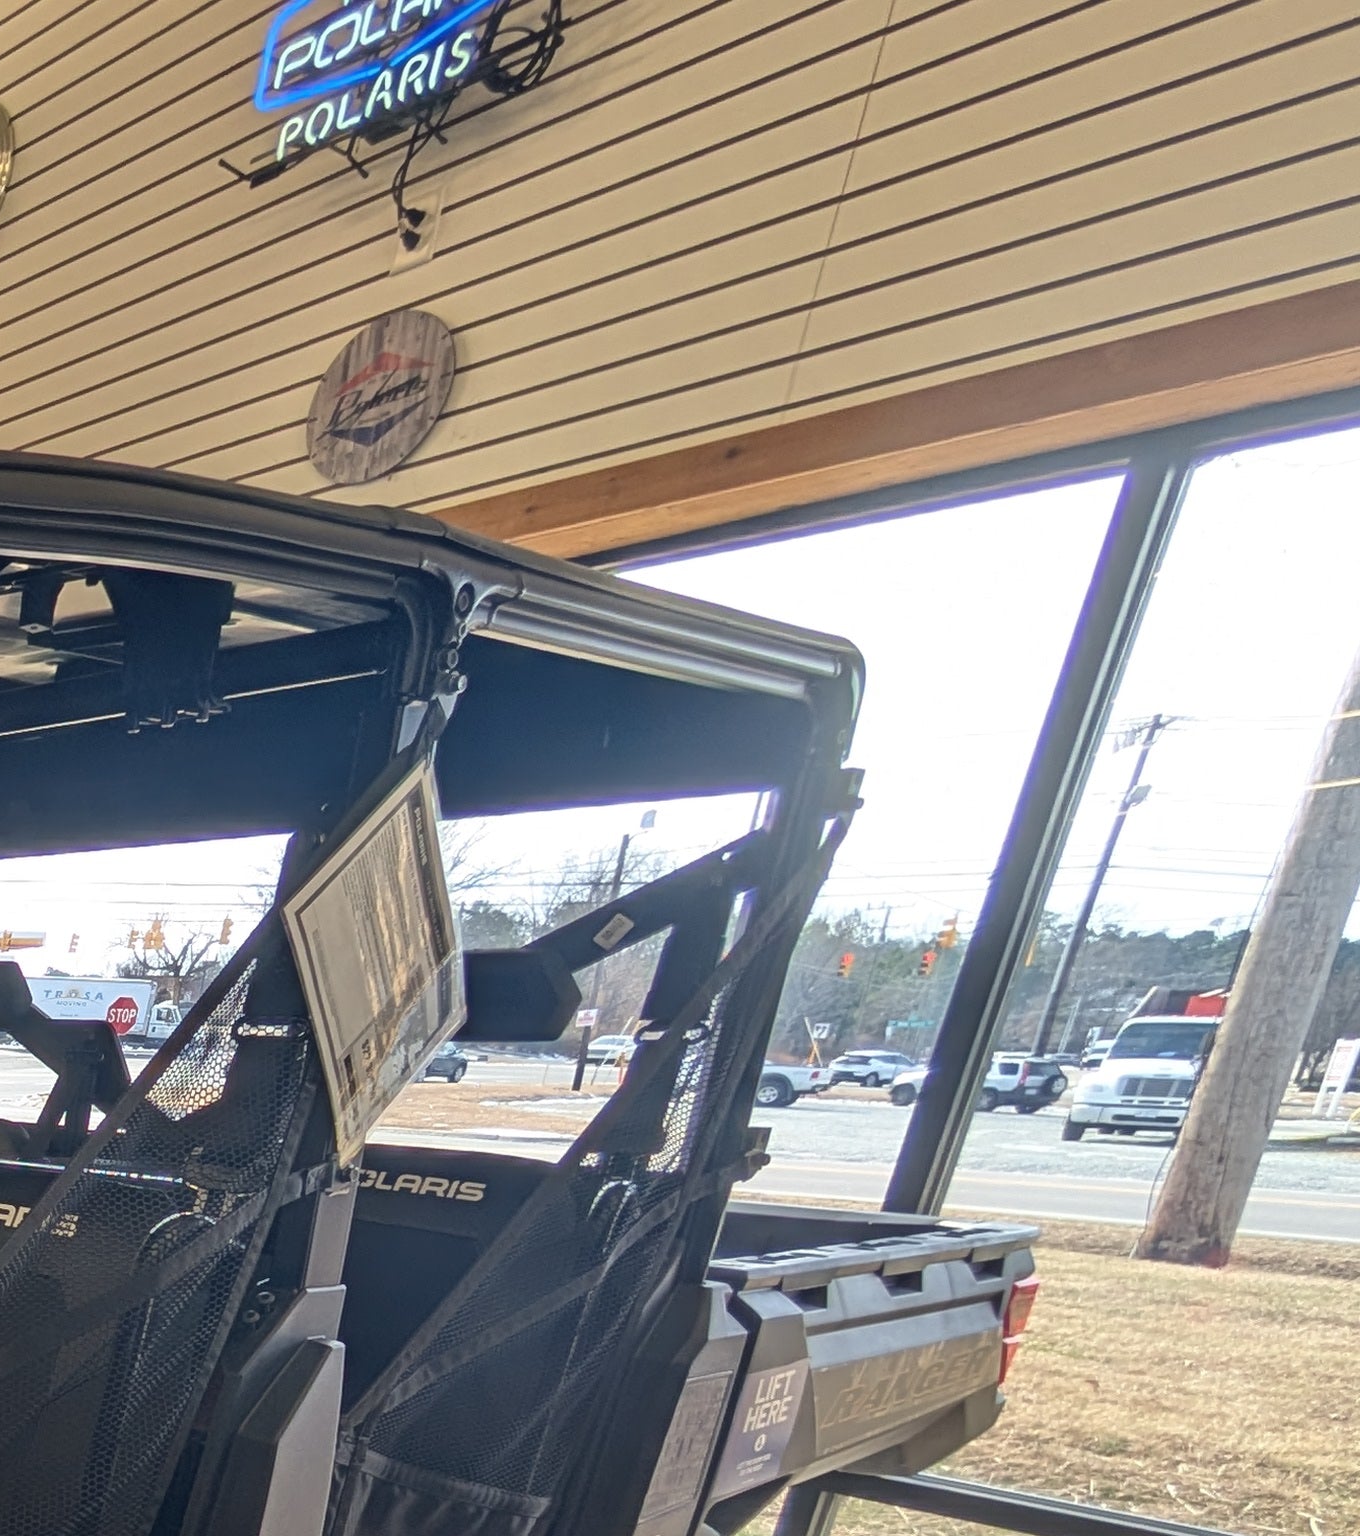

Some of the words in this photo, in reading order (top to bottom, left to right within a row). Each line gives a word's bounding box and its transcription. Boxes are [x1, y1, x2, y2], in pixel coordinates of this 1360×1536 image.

[274, 0, 444, 89] POLA
[276, 31, 474, 161] POLARIS
[107, 1007, 137, 1024] STOP
[358, 1168, 487, 1202] OLARIS
[755, 1369, 797, 1404] LIFT
[742, 1395, 793, 1433] HERE
